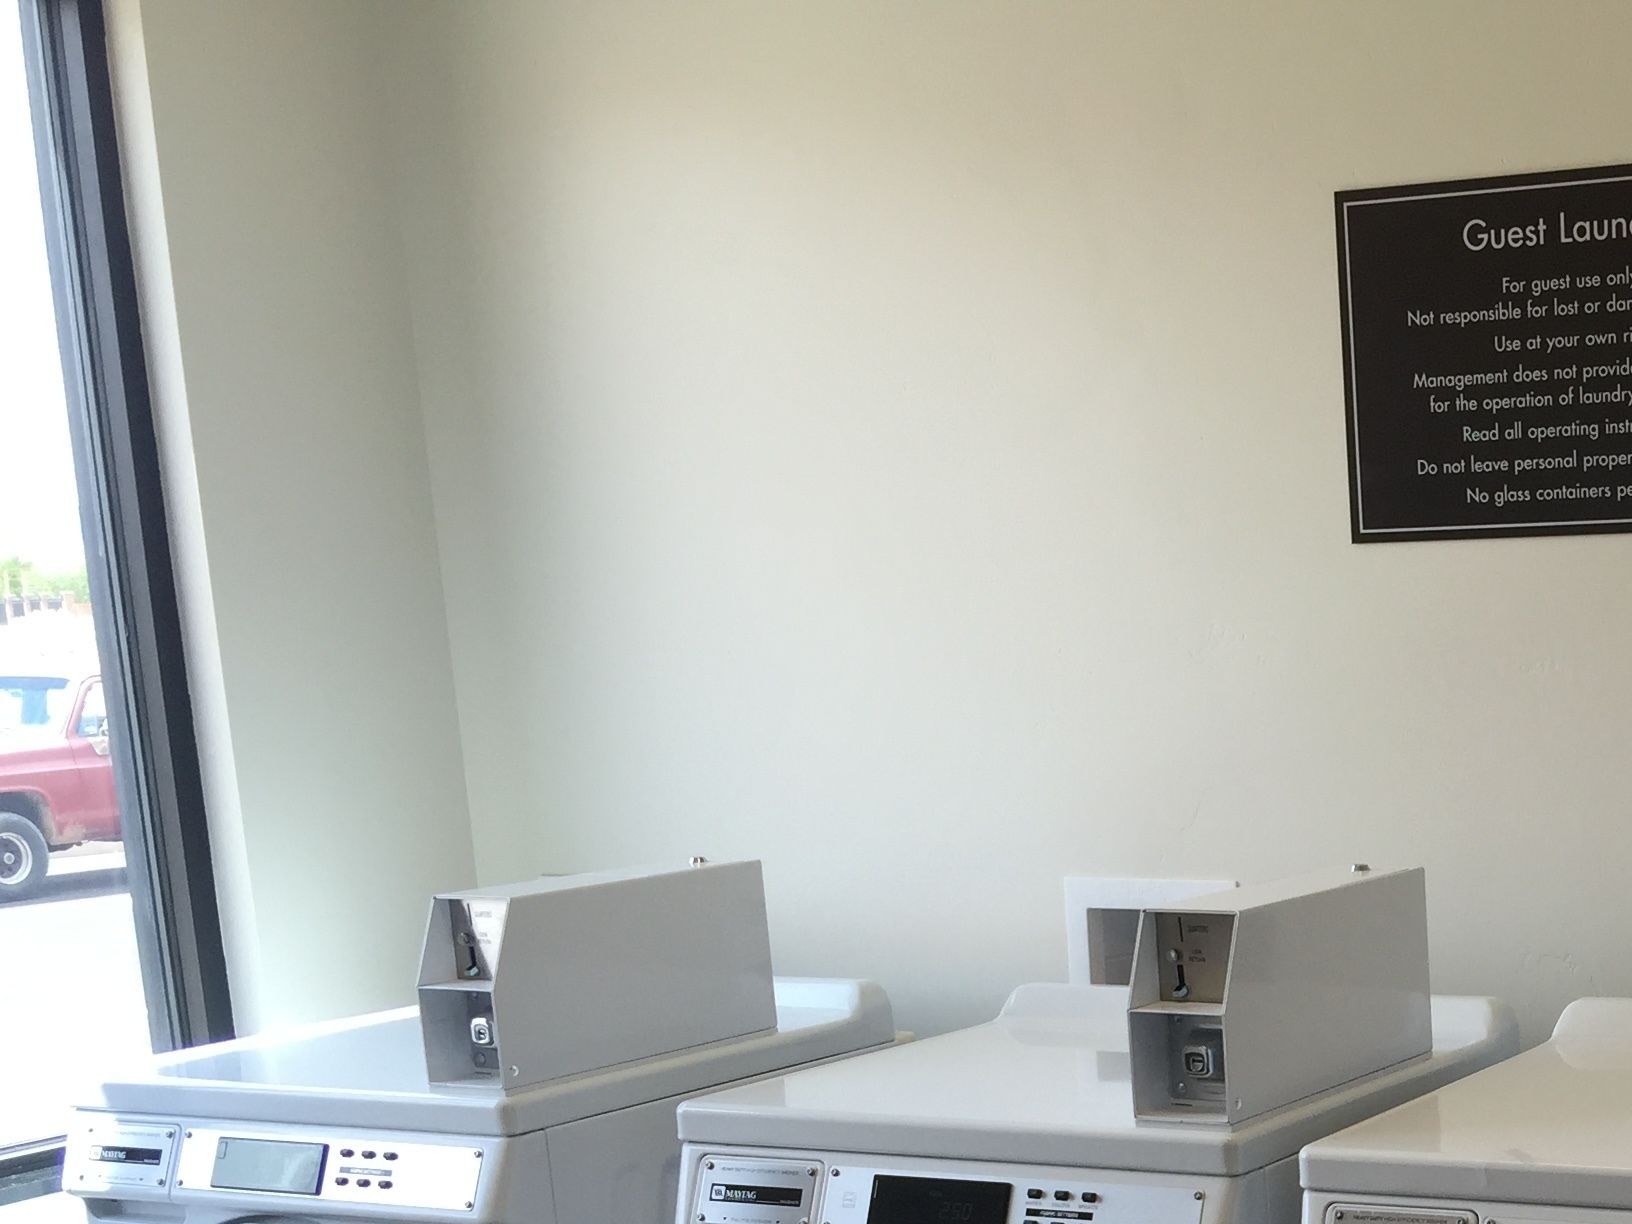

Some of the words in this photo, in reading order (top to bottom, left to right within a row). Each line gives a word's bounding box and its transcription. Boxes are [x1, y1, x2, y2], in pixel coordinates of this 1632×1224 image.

[1462, 217, 1547, 251] Guest
[1502, 277, 1526, 294] For
[1531, 274, 1571, 296] guest
[1576, 275, 1601, 288] use
[1407, 310, 1435, 327] Not
[1440, 301, 1522, 328] responsible
[1527, 299, 1548, 318] for
[1553, 297, 1579, 316] lost
[1584, 301, 1601, 314] or
[1494, 335, 1521, 352] Use
[1526, 335, 1542, 350] at
[1546, 335, 1580, 354] your
[1585, 333, 1617, 346] own
[1413, 369, 1508, 391] Management
[1513, 363, 1548, 383] does
[1554, 364, 1577, 380] not
[1430, 394, 1451, 413] for
[1455, 393, 1478, 411] the
[1482, 391, 1553, 414] operation
[1558, 386, 1574, 406] of
[1462, 422, 1499, 442] Read
[1504, 421, 1522, 440] all
[1527, 420, 1599, 443] operating
[1417, 459, 1438, 475] Do
[1443, 459, 1466, 474] not
[1470, 454, 1509, 473] leave
[1514, 449, 1577, 475] personal
[1466, 487, 1490, 503] No
[1494, 484, 1531, 507] glass
[1536, 483, 1611, 501] containers
[724, 1188, 757, 1199] MAYTAG
